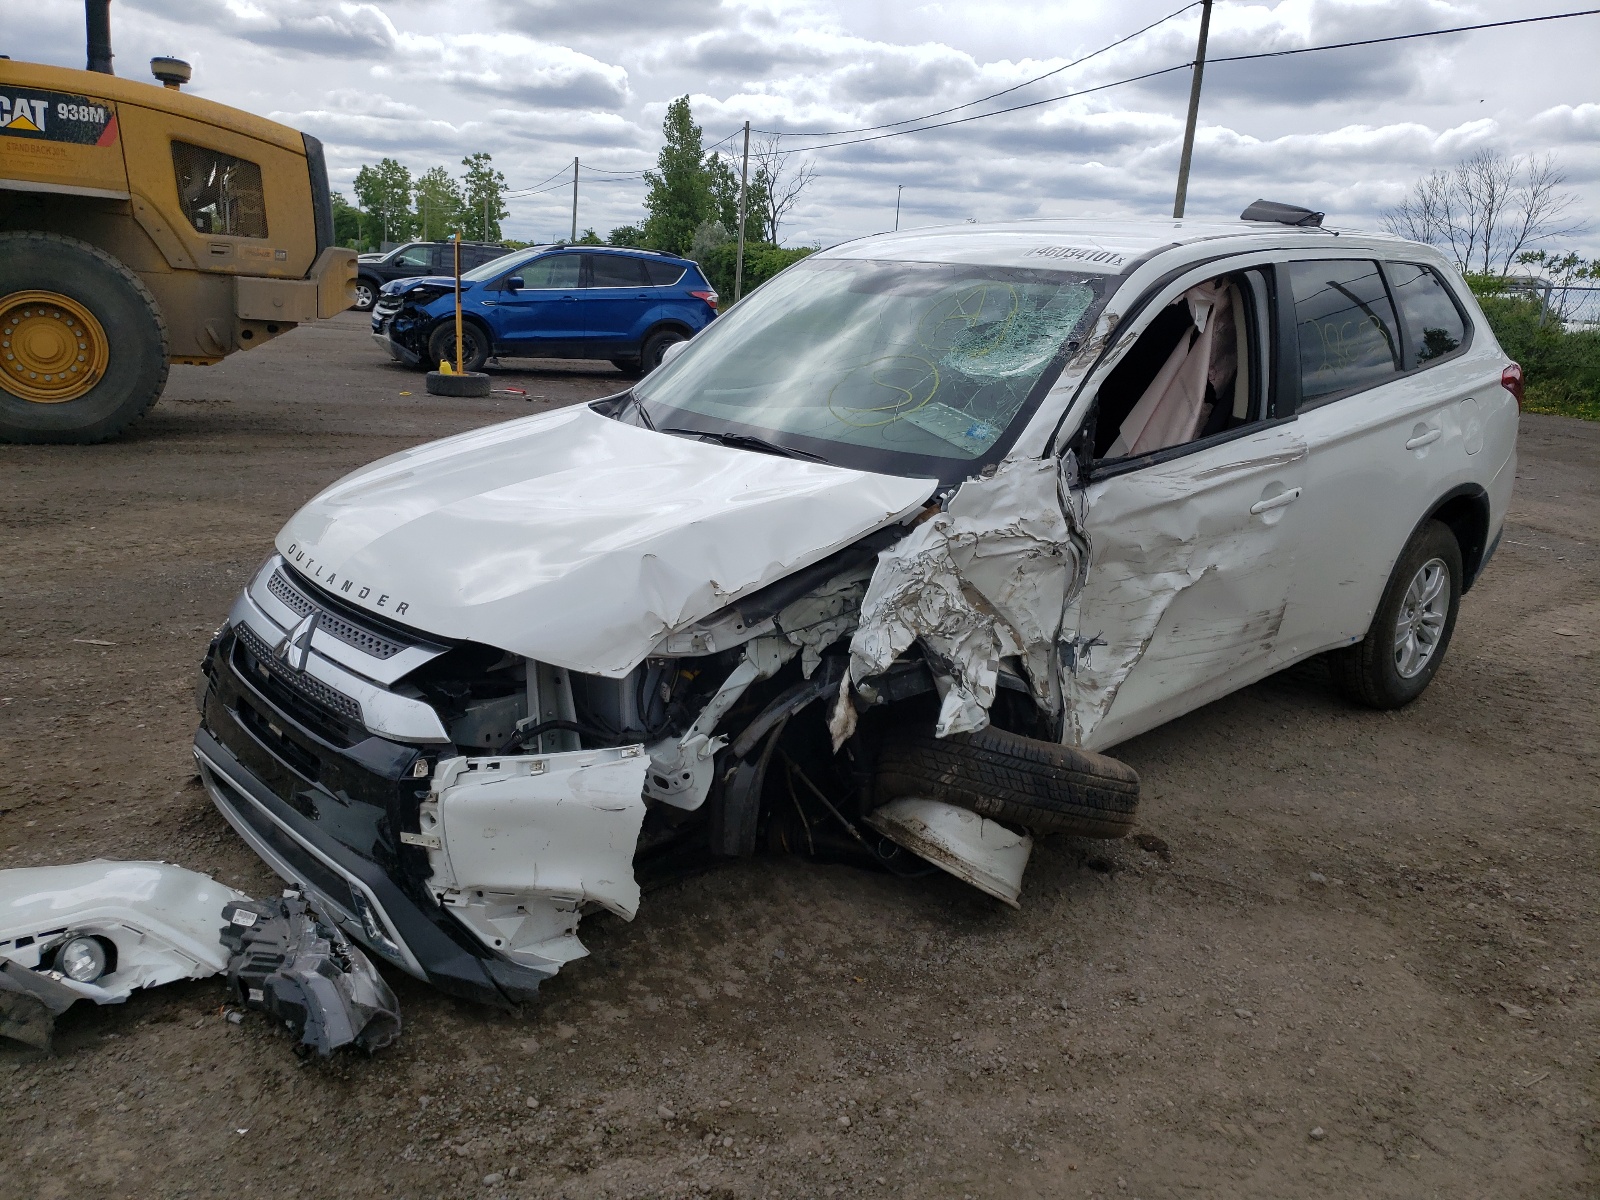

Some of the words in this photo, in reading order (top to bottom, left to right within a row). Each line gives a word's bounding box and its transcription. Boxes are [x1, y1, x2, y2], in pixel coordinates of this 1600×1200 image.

[0, 95, 48, 131] CAT
[57, 103, 105, 124] 938M
[6, 142, 30, 153] STAND
[30, 144, 52, 155] BACK
[287, 543, 410, 616] OUTLANDER
